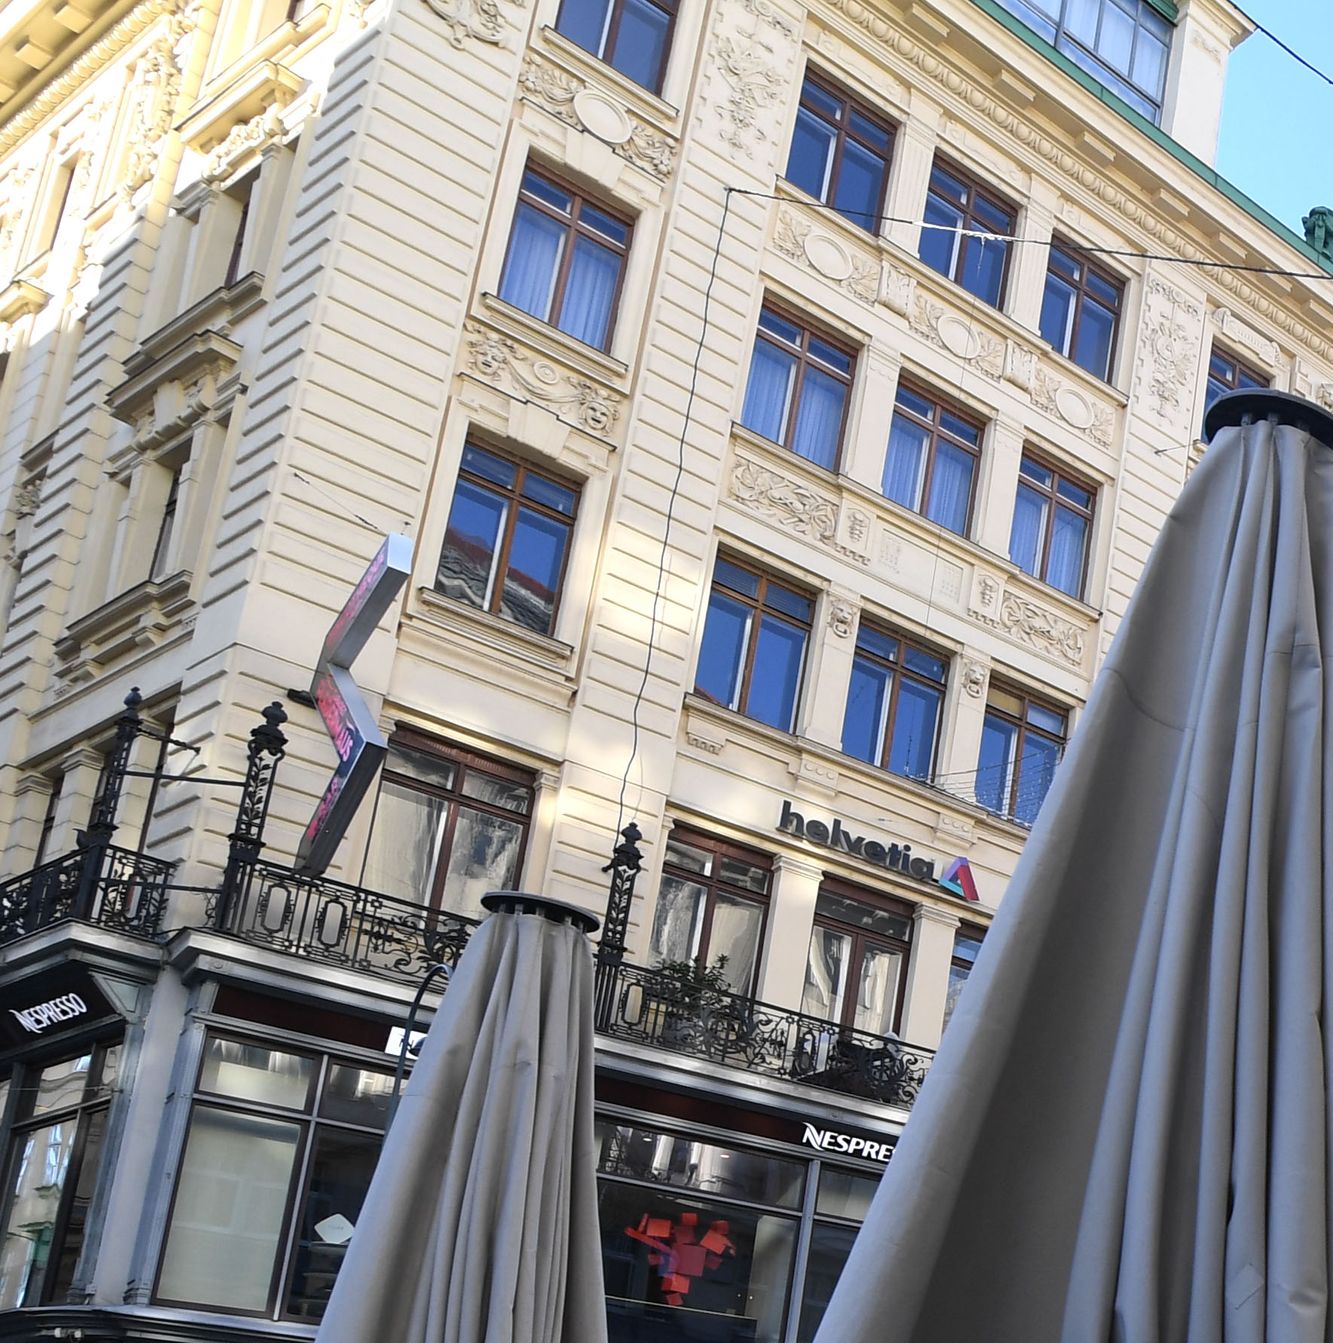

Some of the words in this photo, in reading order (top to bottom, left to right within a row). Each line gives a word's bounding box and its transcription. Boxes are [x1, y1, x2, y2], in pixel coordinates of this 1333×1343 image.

[779, 800, 936, 882] helvetia
[8, 993, 87, 1033] NESPRESSO
[802, 1121, 896, 1162] NESPRE
